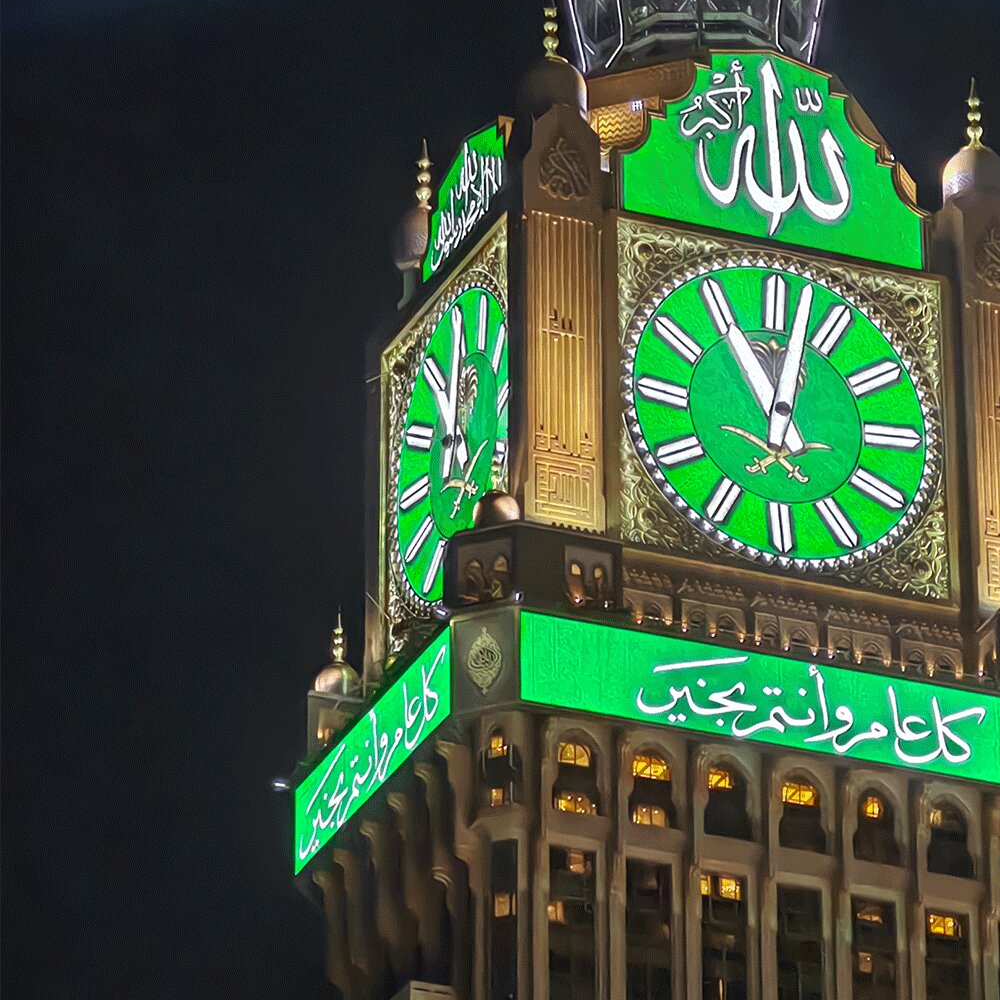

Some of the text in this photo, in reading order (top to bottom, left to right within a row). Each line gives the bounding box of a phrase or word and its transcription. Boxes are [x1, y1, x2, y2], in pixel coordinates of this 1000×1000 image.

[403, 645, 447, 750] كل
[636, 656, 986, 764] كل عام وأنتم بخير
